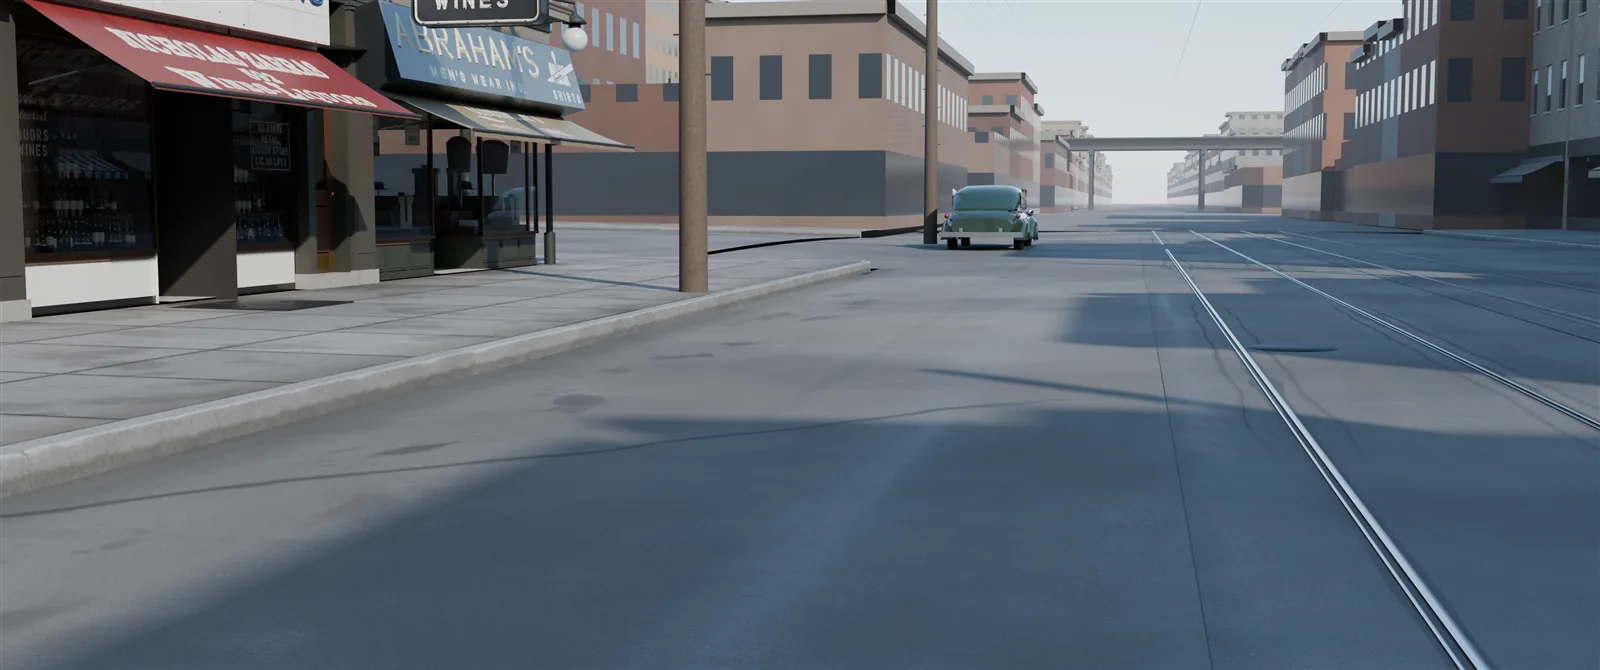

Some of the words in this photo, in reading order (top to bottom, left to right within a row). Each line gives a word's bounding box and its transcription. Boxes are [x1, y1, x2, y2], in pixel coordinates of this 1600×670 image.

[104, 26, 249, 67] NICHOLAS
[394, 11, 540, 78] ABRAHAM'S
[429, 65, 466, 83] MEN'S
[470, 72, 502, 90] WEAR
[505, 80, 526, 94] INC.
[552, 89, 582, 104] SHIRTS
[19, 109, 47, 121] lected
[19, 127, 49, 142] UORS
